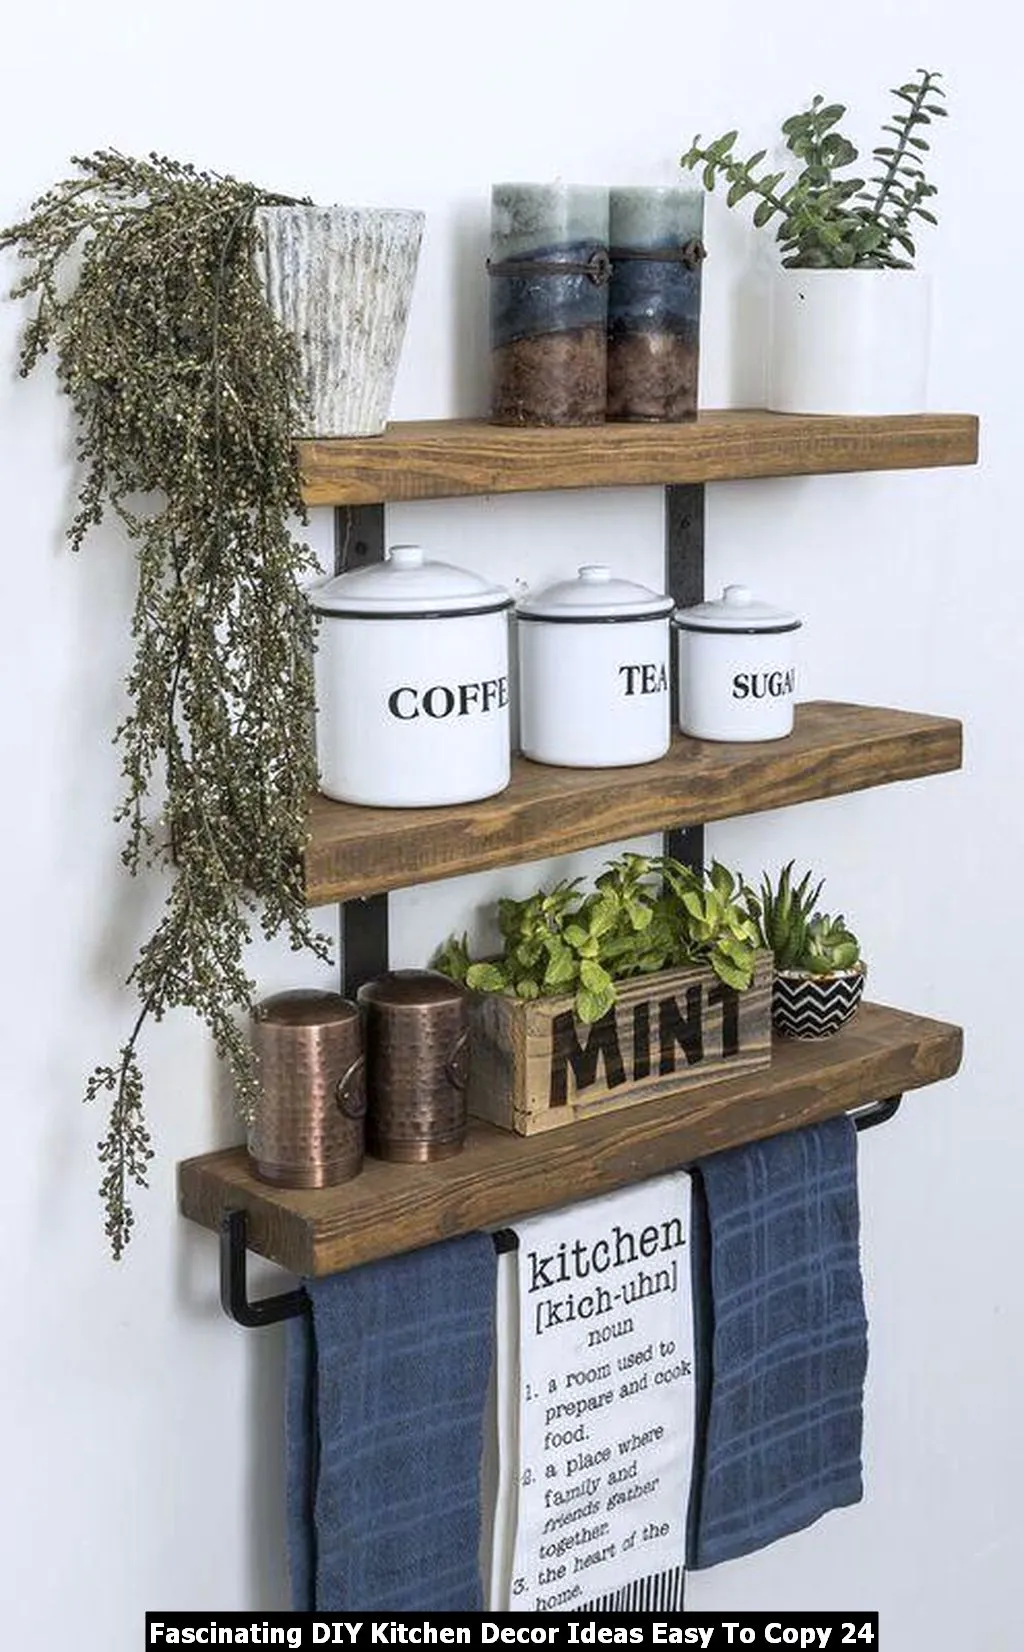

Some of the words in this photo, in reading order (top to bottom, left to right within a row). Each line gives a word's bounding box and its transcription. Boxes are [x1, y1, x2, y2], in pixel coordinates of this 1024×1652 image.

[619, 664, 667, 696] TEA
[549, 982, 739, 1108] MINT
[527, 1216, 686, 1293] kitchen
[535, 1260, 678, 1335] [kich-uhn]
[588, 1317, 634, 1347] noun
[525, 1383, 539, 1401] 1.
[548, 1378, 557, 1394] a
[565, 1363, 612, 1388] room
[617, 1345, 653, 1372] used
[659, 1340, 676, 1358] to
[545, 1391, 614, 1425] prepare
[619, 1373, 648, 1398] and
[654, 1360, 692, 1385] cook
[544, 1424, 590, 1450] food.
[545, 1464, 557, 1478] a
[566, 1447, 612, 1477] place
[618, 1425, 664, 1455] where
[542, 1499, 601, 1535] friends
[606, 1477, 661, 1511] gather
[544, 1476, 602, 1508] family
[607, 1460, 638, 1486] and
[513, 1577, 529, 1595] 3.
[538, 1563, 566, 1586] the
[573, 1543, 618, 1574] heart
[622, 1531, 637, 1553] of
[642, 1522, 670, 1542] the
[538, 1521, 610, 1559] together.
[535, 1583, 584, 1612] home.
